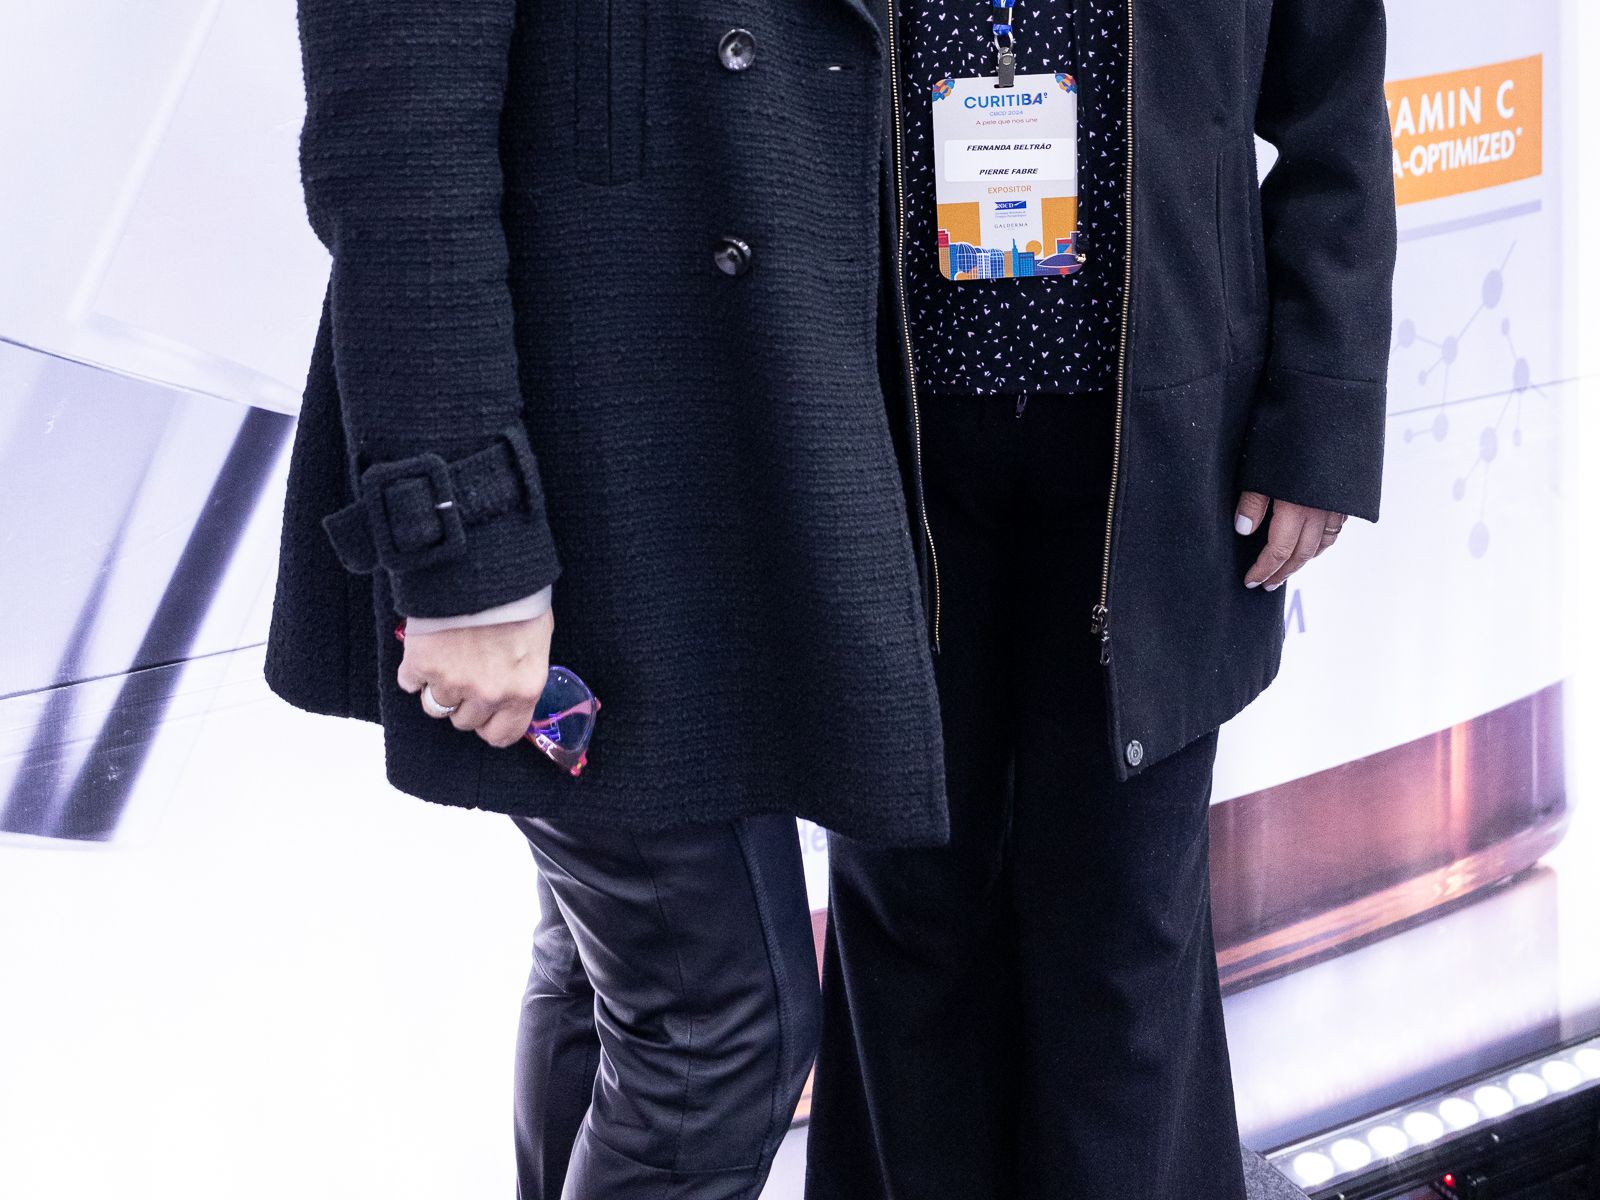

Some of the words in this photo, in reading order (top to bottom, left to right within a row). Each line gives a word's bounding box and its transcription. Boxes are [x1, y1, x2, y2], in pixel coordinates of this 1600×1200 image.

[1387, 86, 1482, 138] AMIN
[1496, 80, 1515, 120] C
[966, 144, 1011, 152] FERNANDA
[1011, 167, 1039, 175] FABRE
[987, 185, 1032, 194] EXPOSITOR
